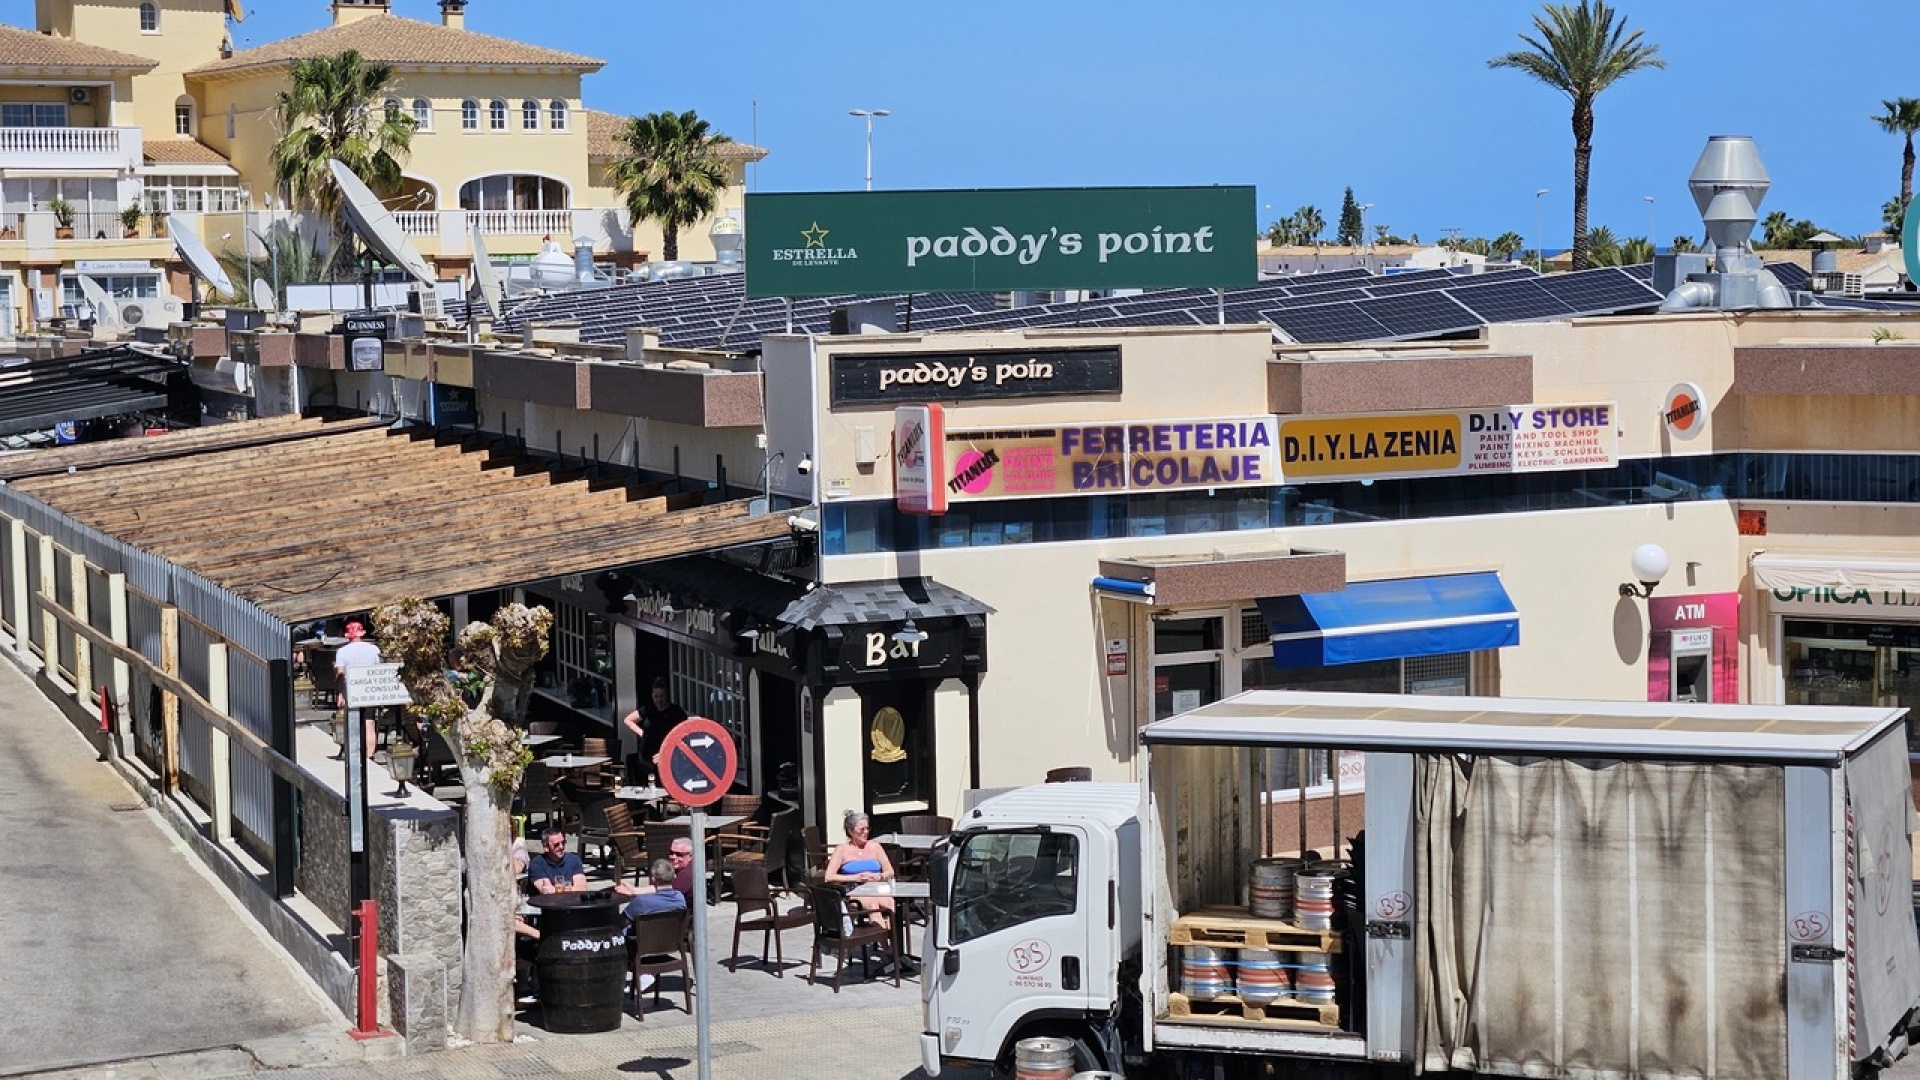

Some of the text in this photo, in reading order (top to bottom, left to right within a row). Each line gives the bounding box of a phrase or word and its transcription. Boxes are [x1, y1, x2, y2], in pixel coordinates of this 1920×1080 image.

[906, 225, 1082, 267] paddy's
[773, 248, 858, 260] ESTRELLA
[347, 320, 385, 330] GUINNESS
[879, 356, 988, 391] paddy's
[1532, 407, 1609, 429] STORE
[1061, 422, 1270, 456] FERRETERIA
[1480, 428, 1600, 442] PAINT AND TOOL SHOP
[1480, 439, 1600, 451] PAINT MIXING MACHINE
[1003, 455, 1055, 470] PAINT
[1468, 460, 1511, 469] PLUMBING
[1518, 459, 1556, 467] ELECTRIC
[1563, 456, 1609, 465] GARDENING
[1474, 452, 1489, 460] WE
[1493, 451, 1512, 460] CUT
[947, 448, 1000, 494] TITANLUX
[1072, 455, 1262, 489] BRICOLAJE
[1674, 603, 1705, 620] ATM
[866, 631, 929, 667] Bar
[367, 668, 397, 676] EXCEPTO
[350, 677, 372, 686] CARGA
[365, 685, 400, 694] CONSUM
